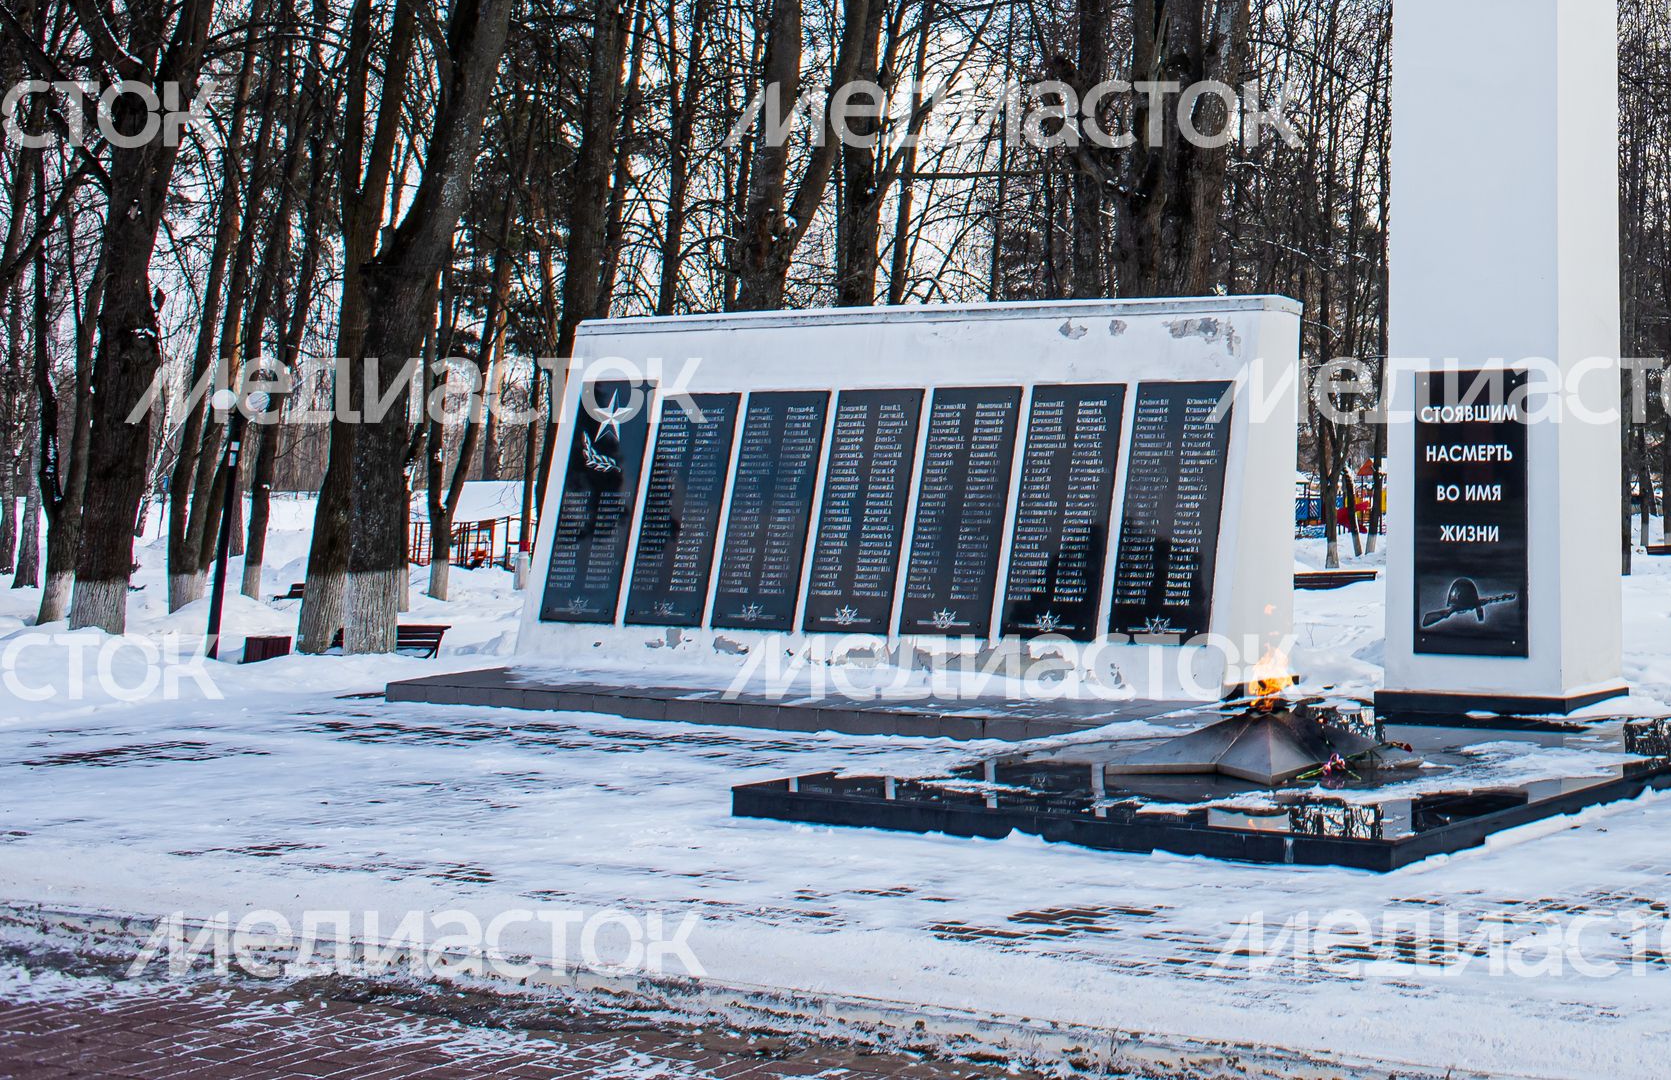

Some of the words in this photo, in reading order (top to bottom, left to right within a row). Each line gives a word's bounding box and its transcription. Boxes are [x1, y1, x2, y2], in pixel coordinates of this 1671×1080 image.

[1421, 404, 1517, 423] СТОЯВШИМ
[1426, 444, 1513, 462] НАСМЕРТЬ
[1436, 485, 1460, 502] ВО
[1465, 485, 1502, 501] ИМЯ
[1440, 526, 1499, 542] ЖИЗНИ
